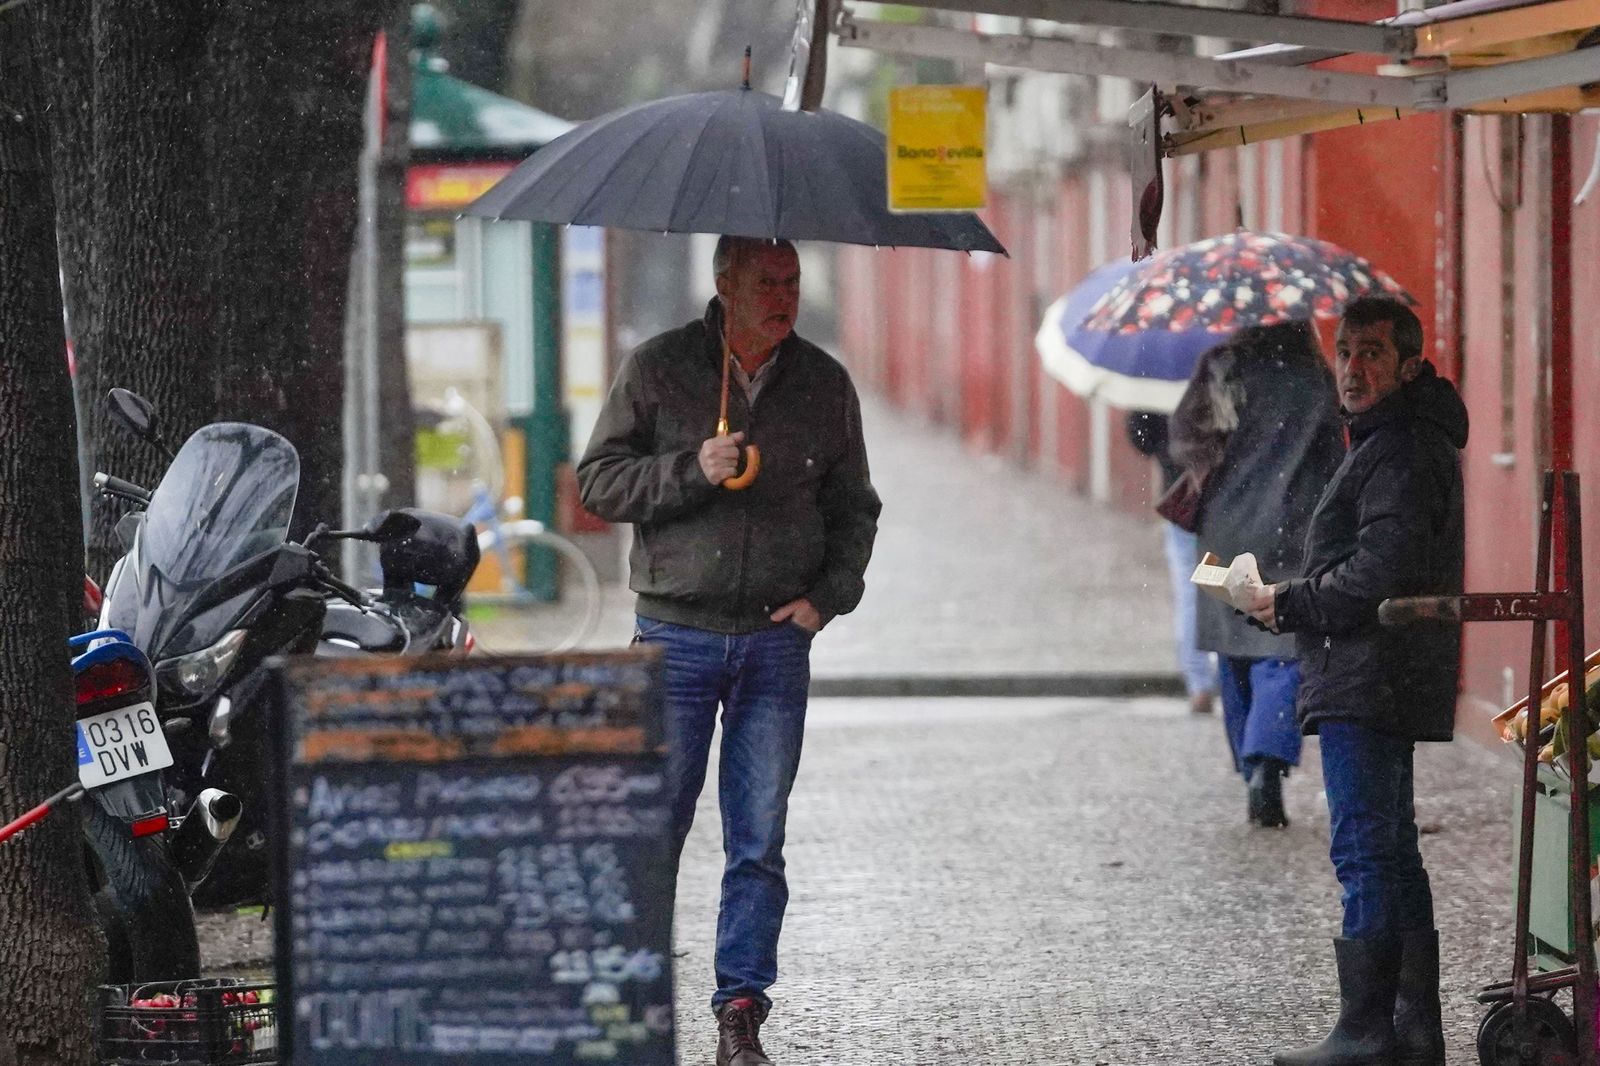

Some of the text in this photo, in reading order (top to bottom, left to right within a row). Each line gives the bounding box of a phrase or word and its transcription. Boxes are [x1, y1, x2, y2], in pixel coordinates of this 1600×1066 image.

[88, 709, 155, 747] 0316
[78, 747, 87, 758] E
[97, 740, 149, 777] DVW
